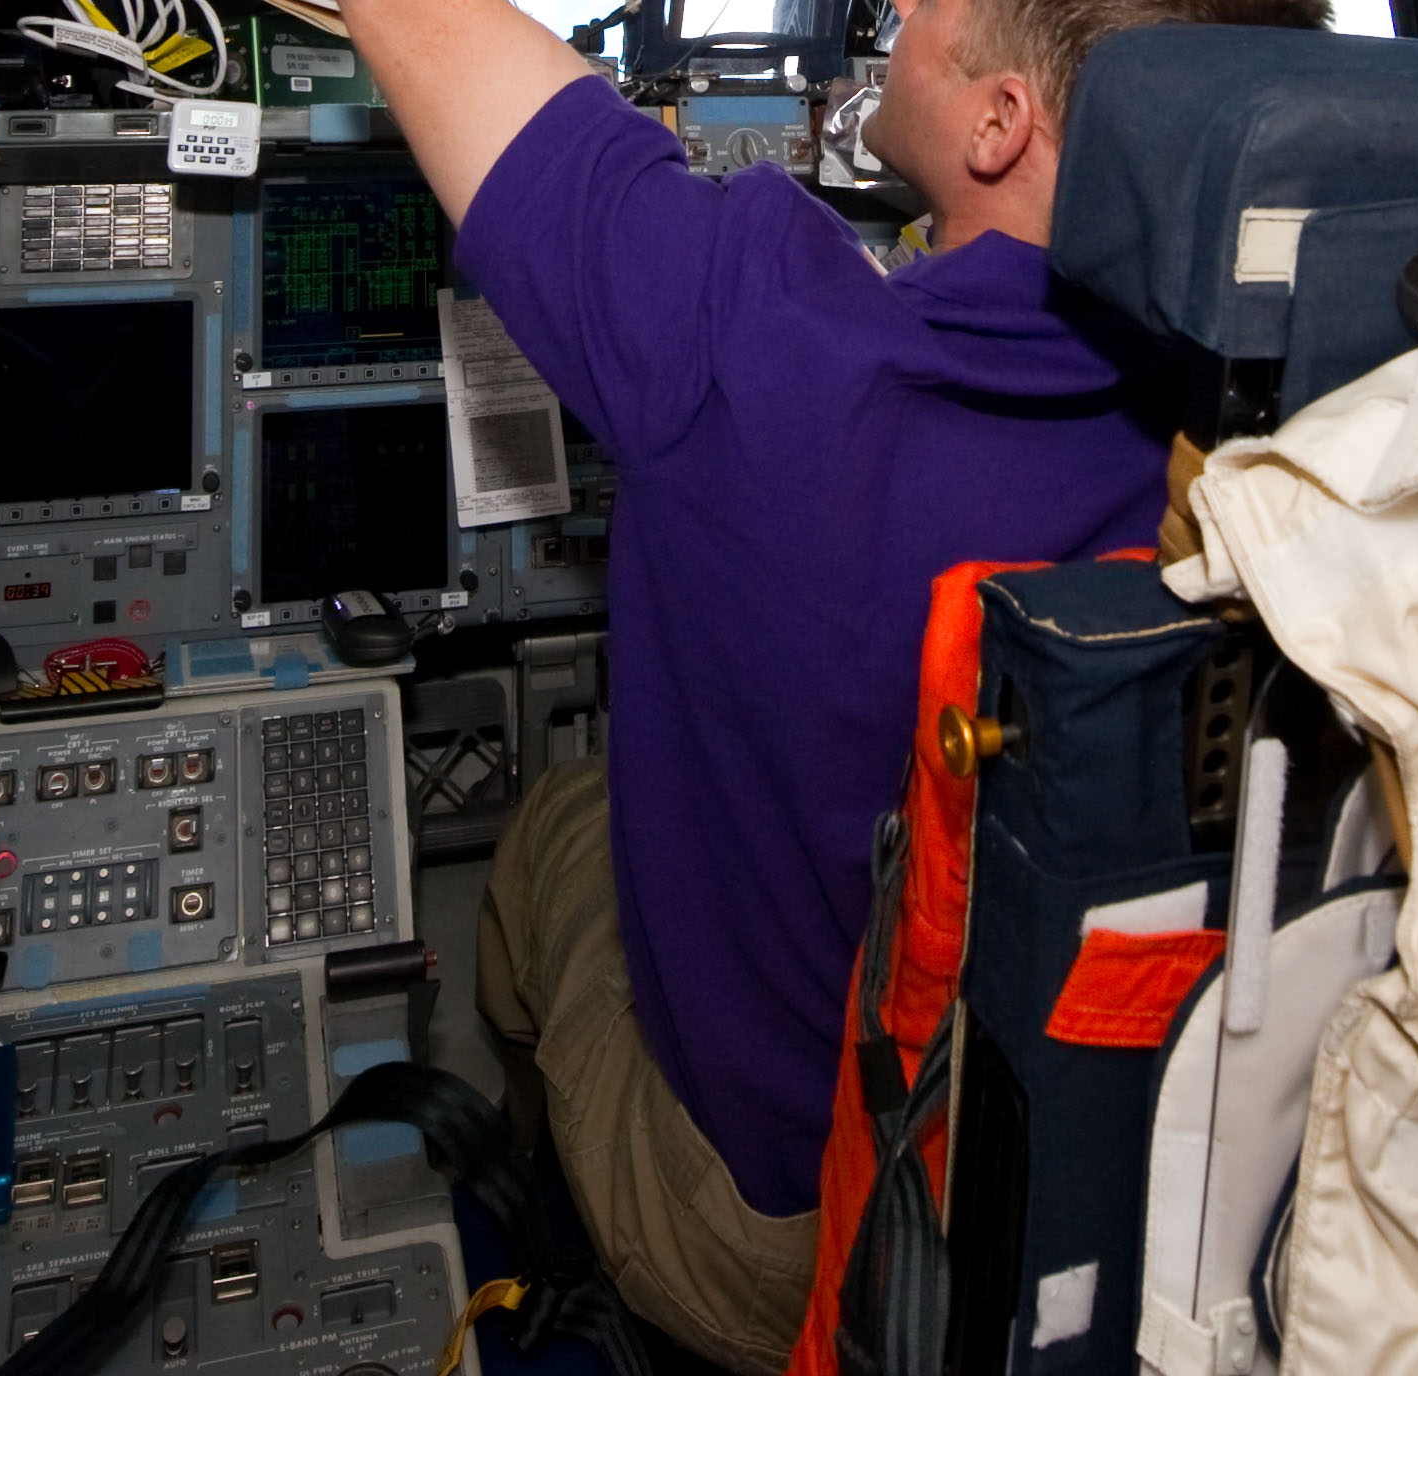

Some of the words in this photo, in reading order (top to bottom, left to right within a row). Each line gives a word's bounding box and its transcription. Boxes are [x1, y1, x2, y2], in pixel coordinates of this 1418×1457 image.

[7, 544, 29, 553] EVENT
[72, 850, 97, 858] TIMER
[147, 1146, 170, 1157] ROLL
[172, 1141, 197, 1153] TRIM
[26, 1260, 46, 1272] SRB
[354, 1267, 381, 1280] TRIM
[321, 1332, 338, 1344] PM
